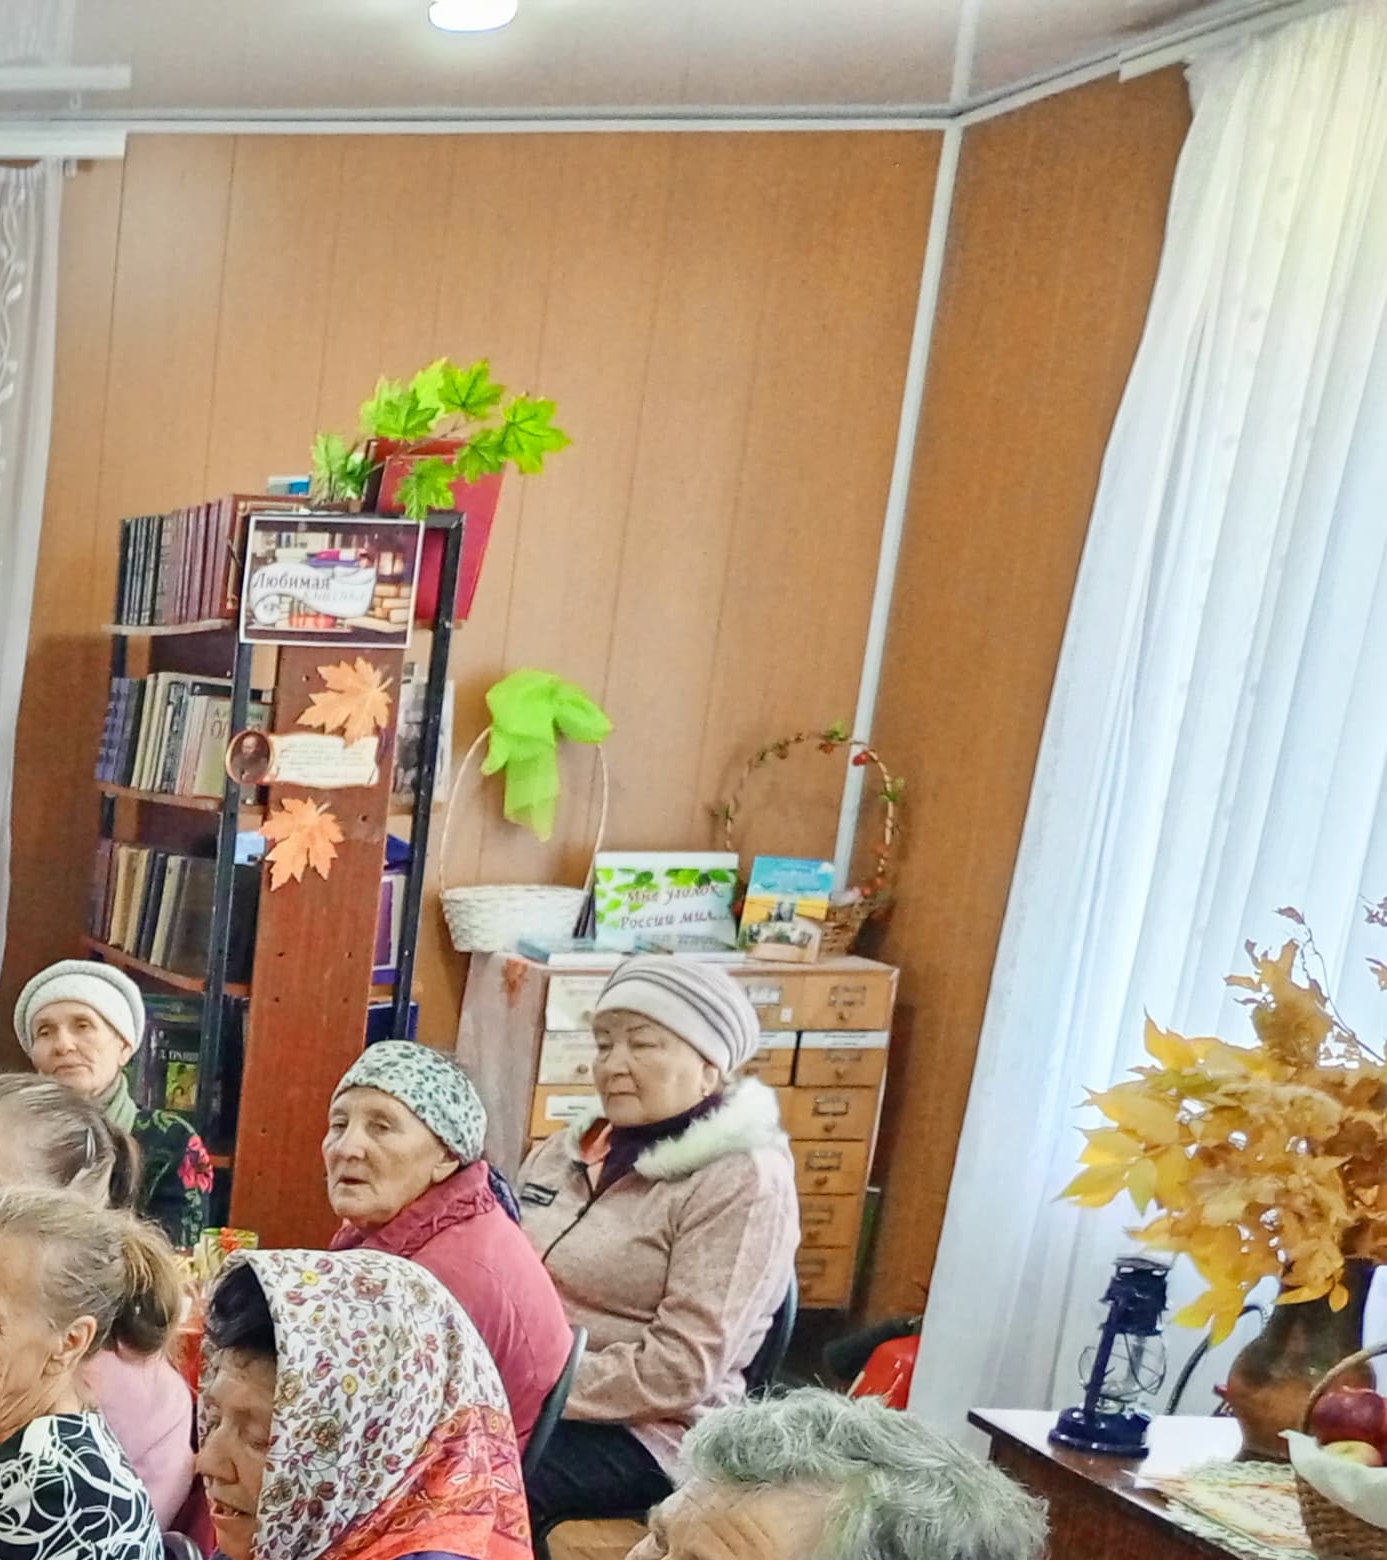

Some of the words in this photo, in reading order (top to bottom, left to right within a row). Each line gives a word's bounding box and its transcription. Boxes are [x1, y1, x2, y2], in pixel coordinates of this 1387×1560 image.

[252, 572, 331, 590] Любимая
[665, 884, 724, 905] уголок
[619, 913, 674, 929] России
